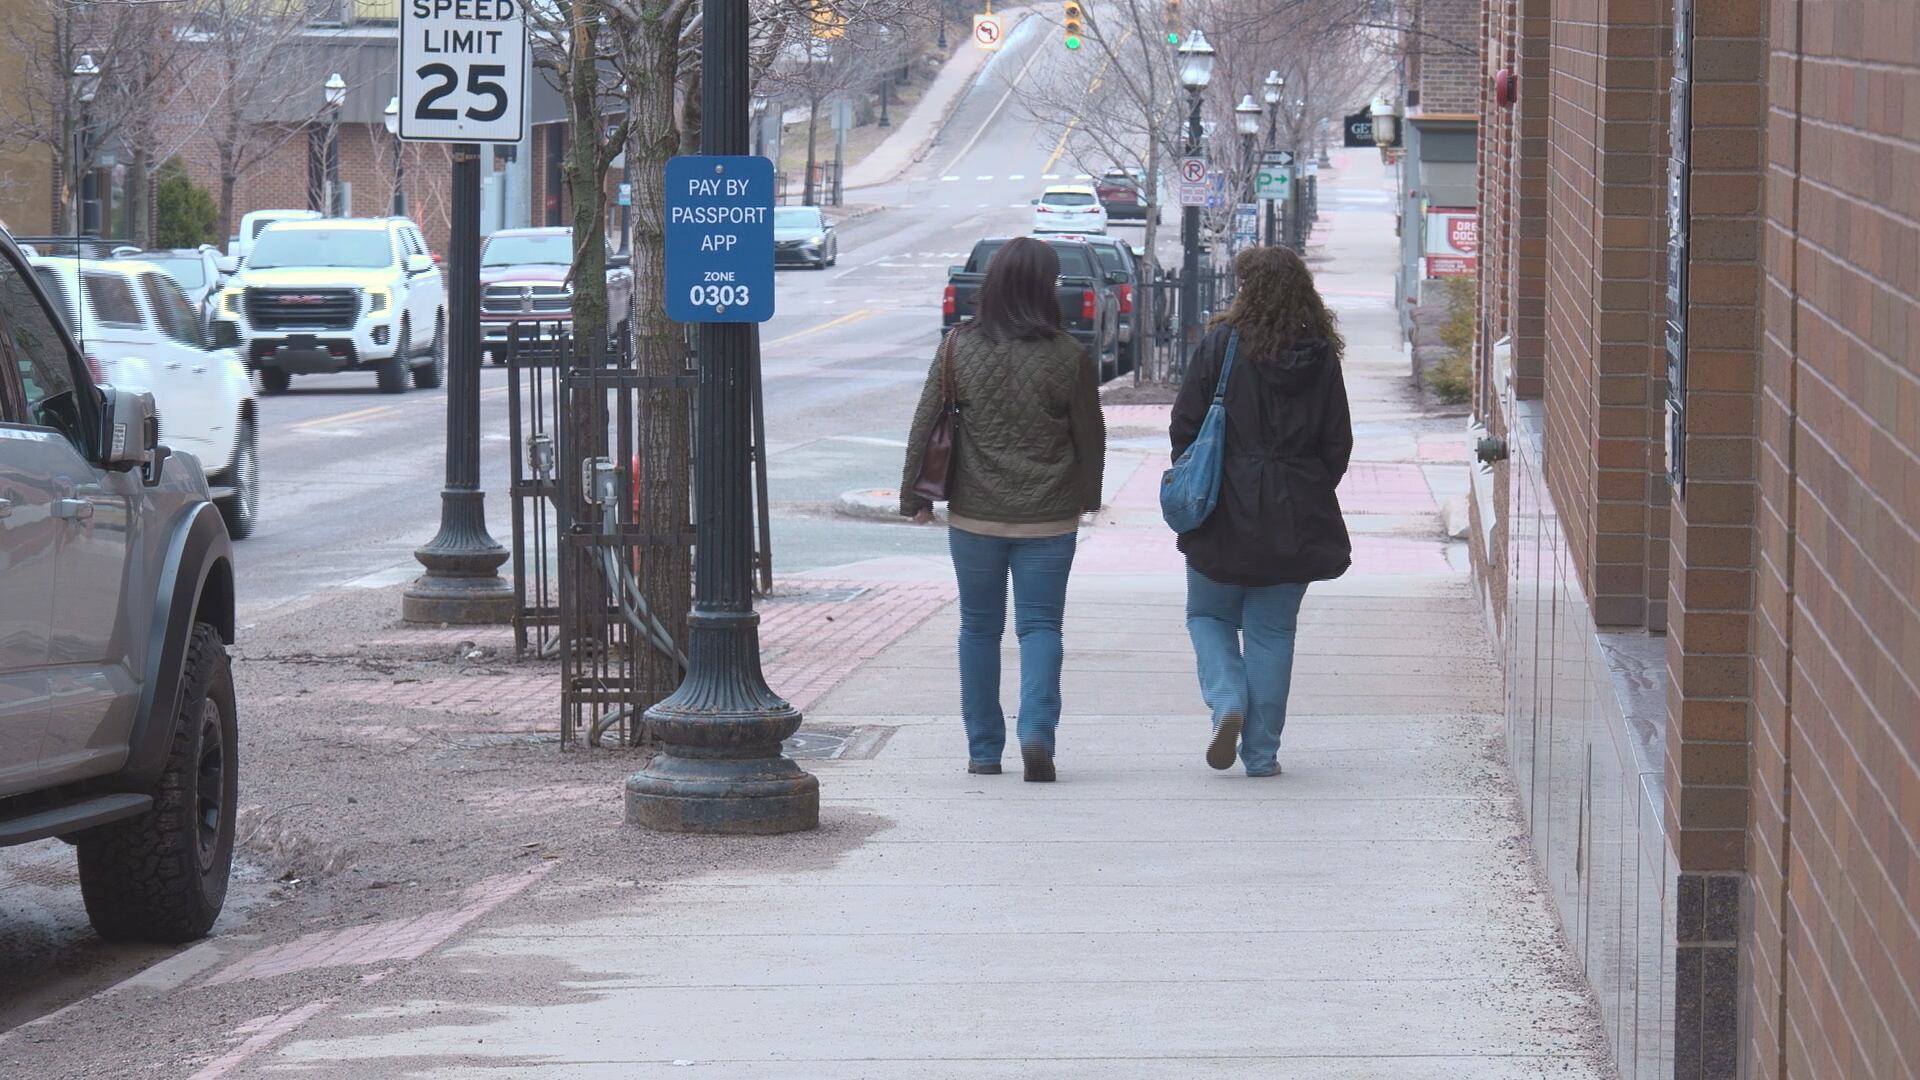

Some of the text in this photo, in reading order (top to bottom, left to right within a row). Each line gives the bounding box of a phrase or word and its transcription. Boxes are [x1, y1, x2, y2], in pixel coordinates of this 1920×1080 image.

[413, 0, 514, 20] SPEED
[424, 29, 503, 54] LIMIT
[414, 62, 509, 122] 25
[688, 179, 750, 196] PAY BY
[671, 206, 767, 224] PASSPORT
[700, 234, 737, 251] APP
[703, 271, 735, 282] ZONE
[689, 285, 750, 306] 0303
